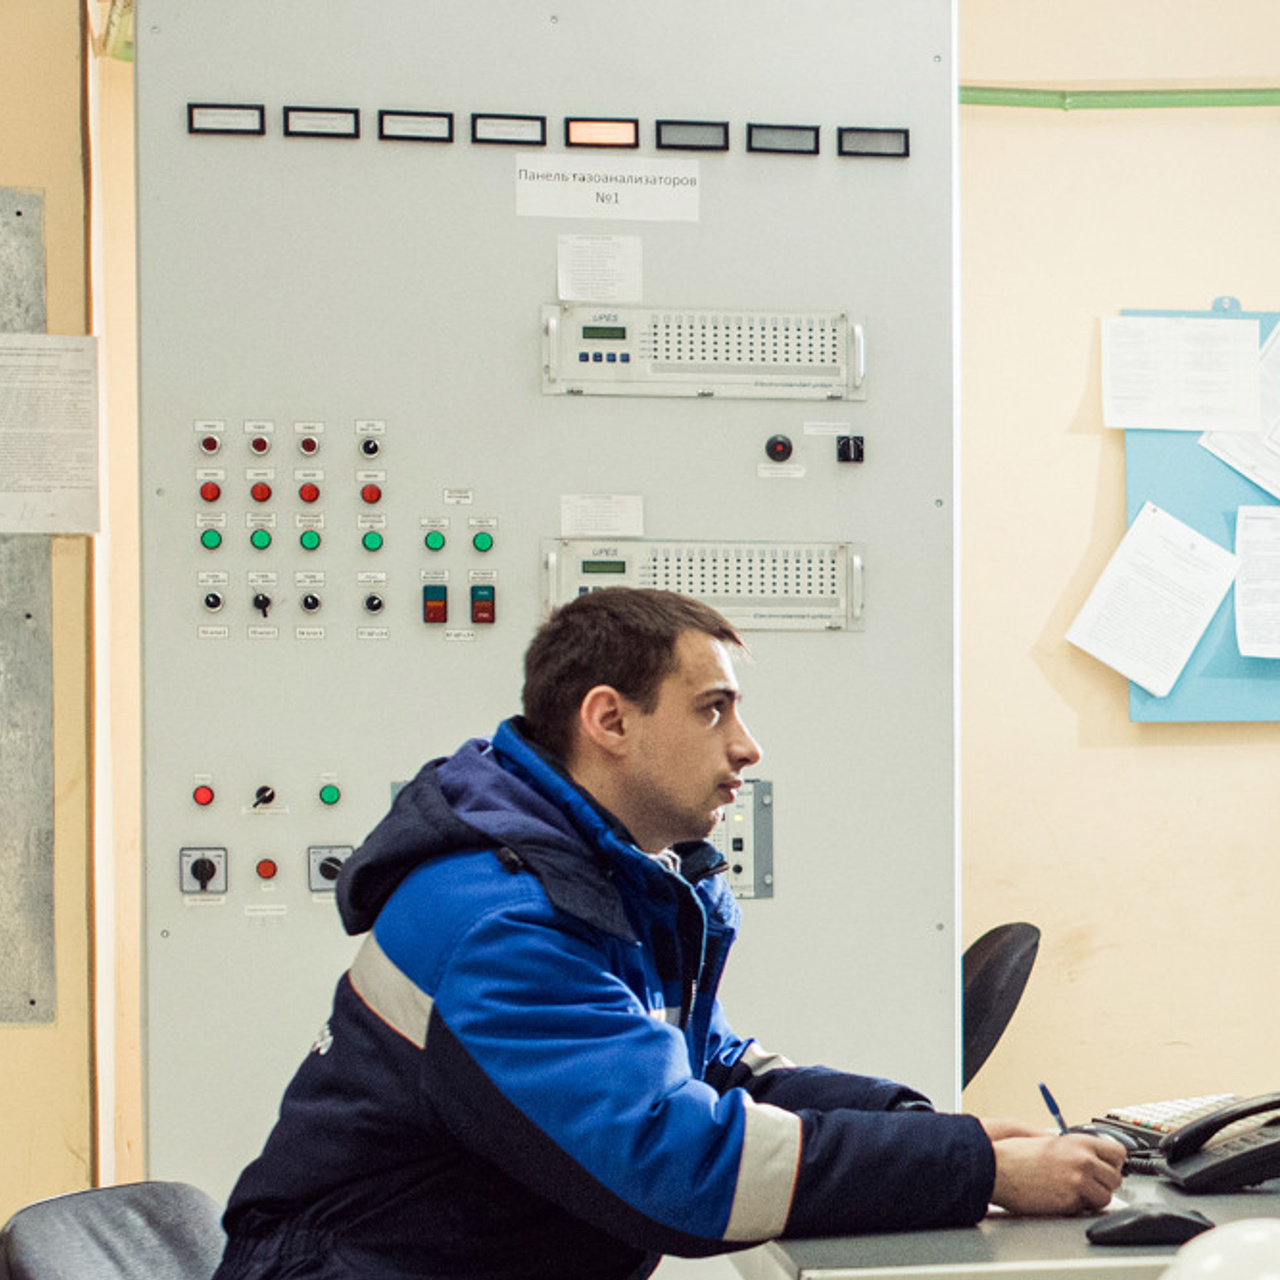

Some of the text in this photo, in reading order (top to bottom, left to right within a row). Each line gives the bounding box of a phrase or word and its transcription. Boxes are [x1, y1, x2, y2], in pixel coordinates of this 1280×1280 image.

[518, 169, 697, 187] Панель газоанализаторов
[595, 192, 620, 205] №1
